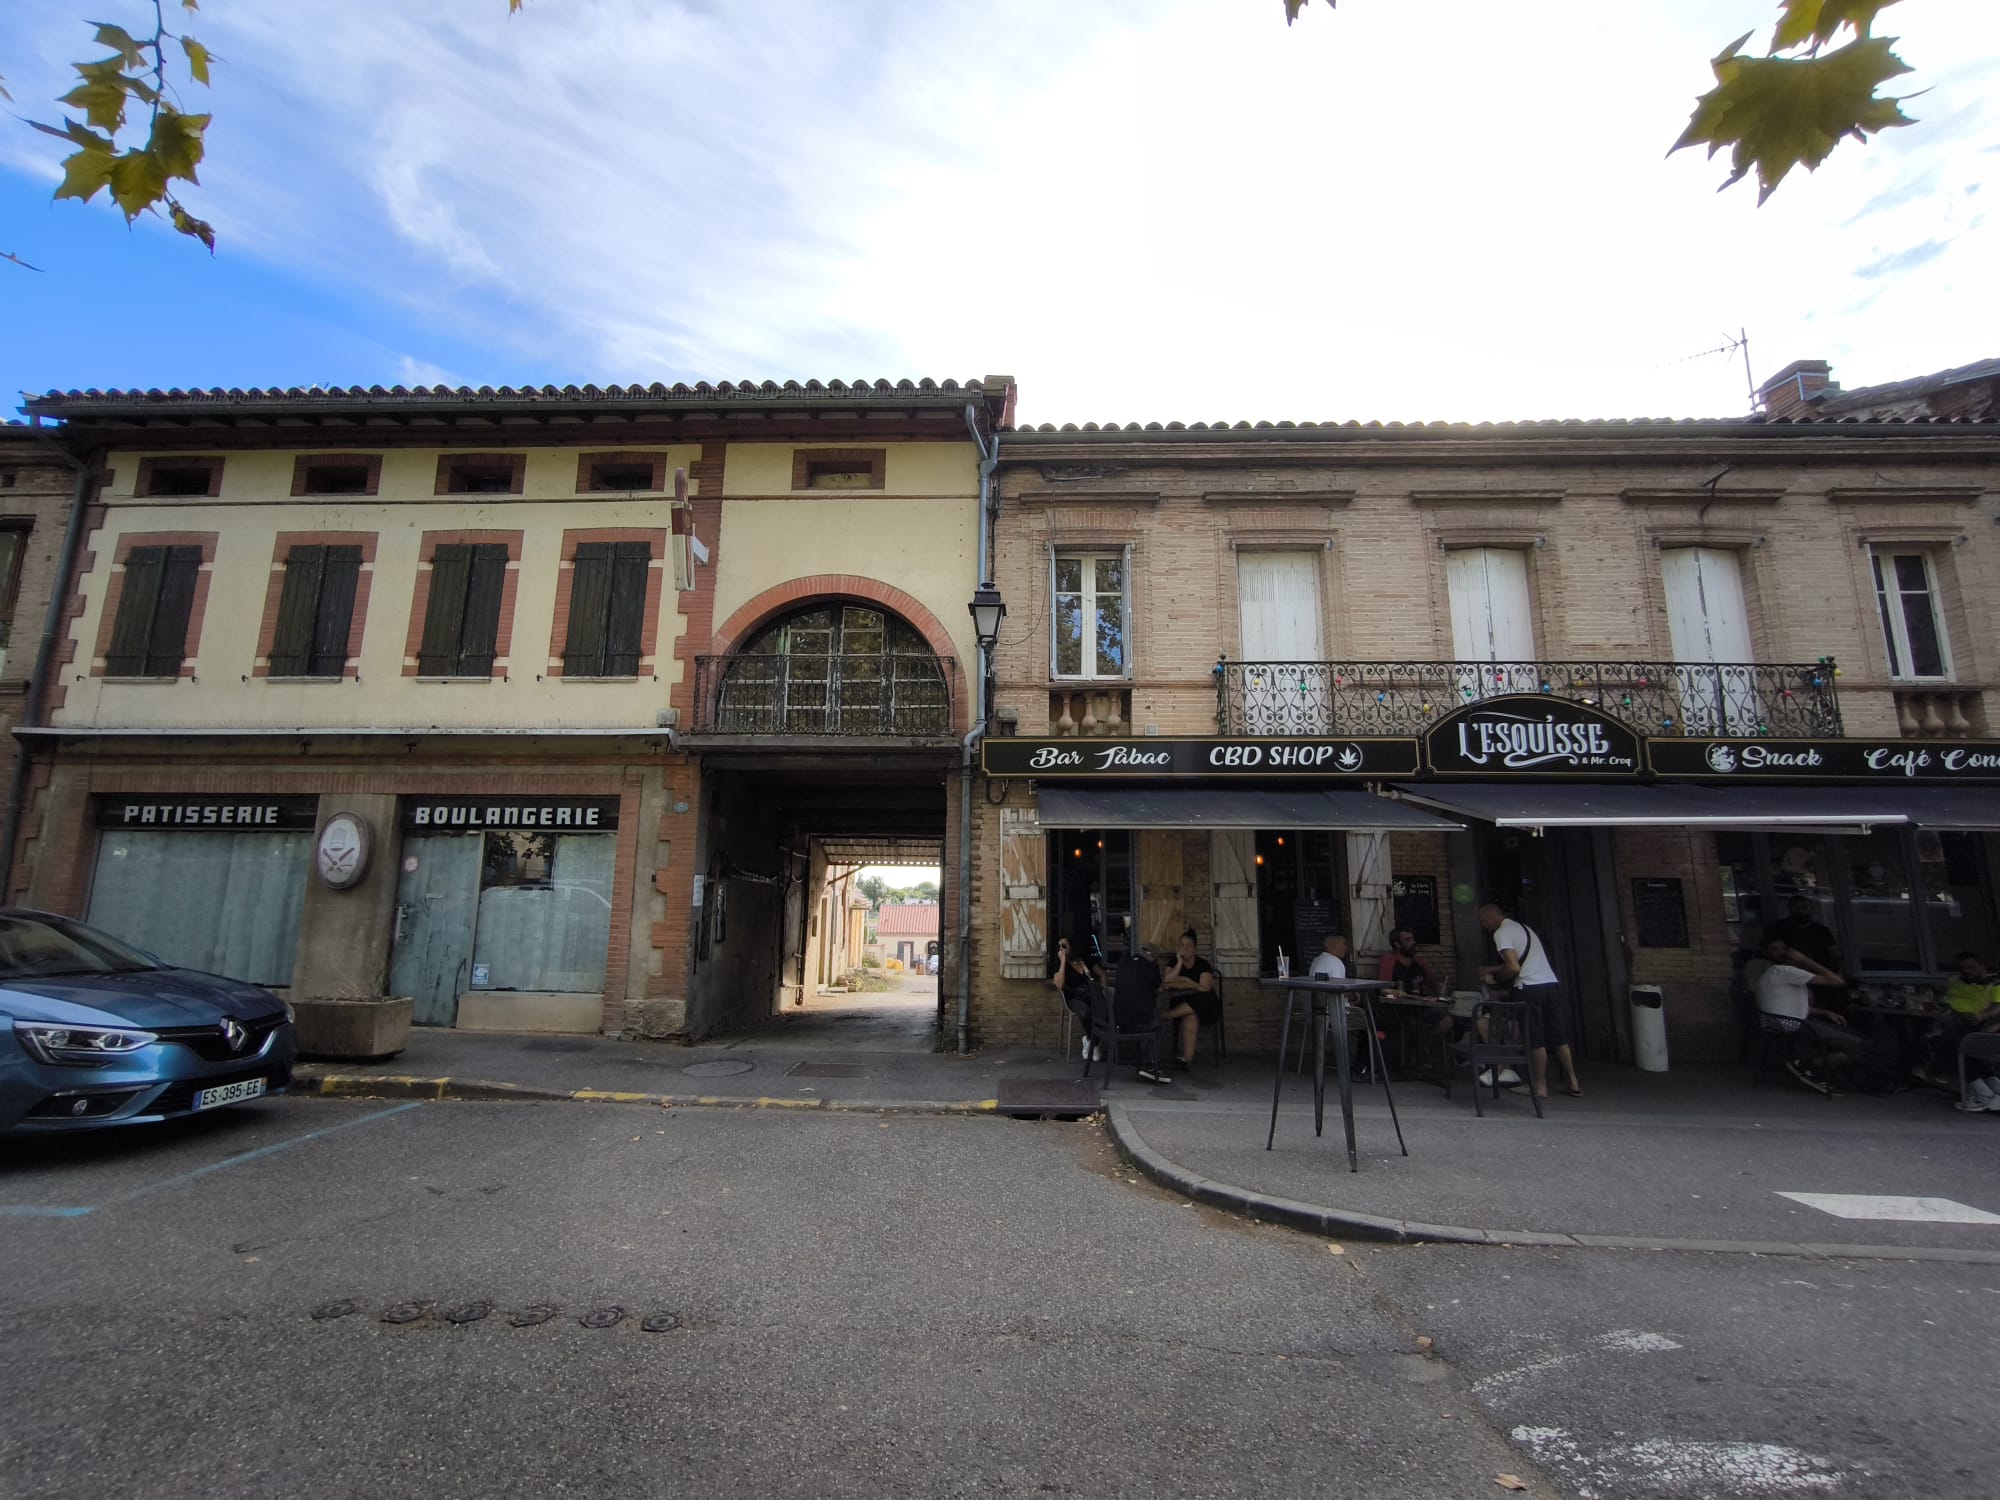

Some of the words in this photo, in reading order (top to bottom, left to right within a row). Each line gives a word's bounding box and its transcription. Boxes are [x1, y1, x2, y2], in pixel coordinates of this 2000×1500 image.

[1029, 747, 1084, 769] Bar
[1094, 746, 1171, 770] Tabac
[1209, 745, 1263, 766] CBD
[1268, 745, 1334, 766] SHOP
[1590, 756, 1607, 765] Mr.
[1609, 755, 1632, 768] Croq
[1741, 745, 1823, 768] Snack
[1863, 748, 1932, 777] Café
[123, 805, 279, 824] PATISSERIE
[415, 806, 600, 825] BOULANGERIE
[202, 1080, 260, 1106] ES-395-EE
